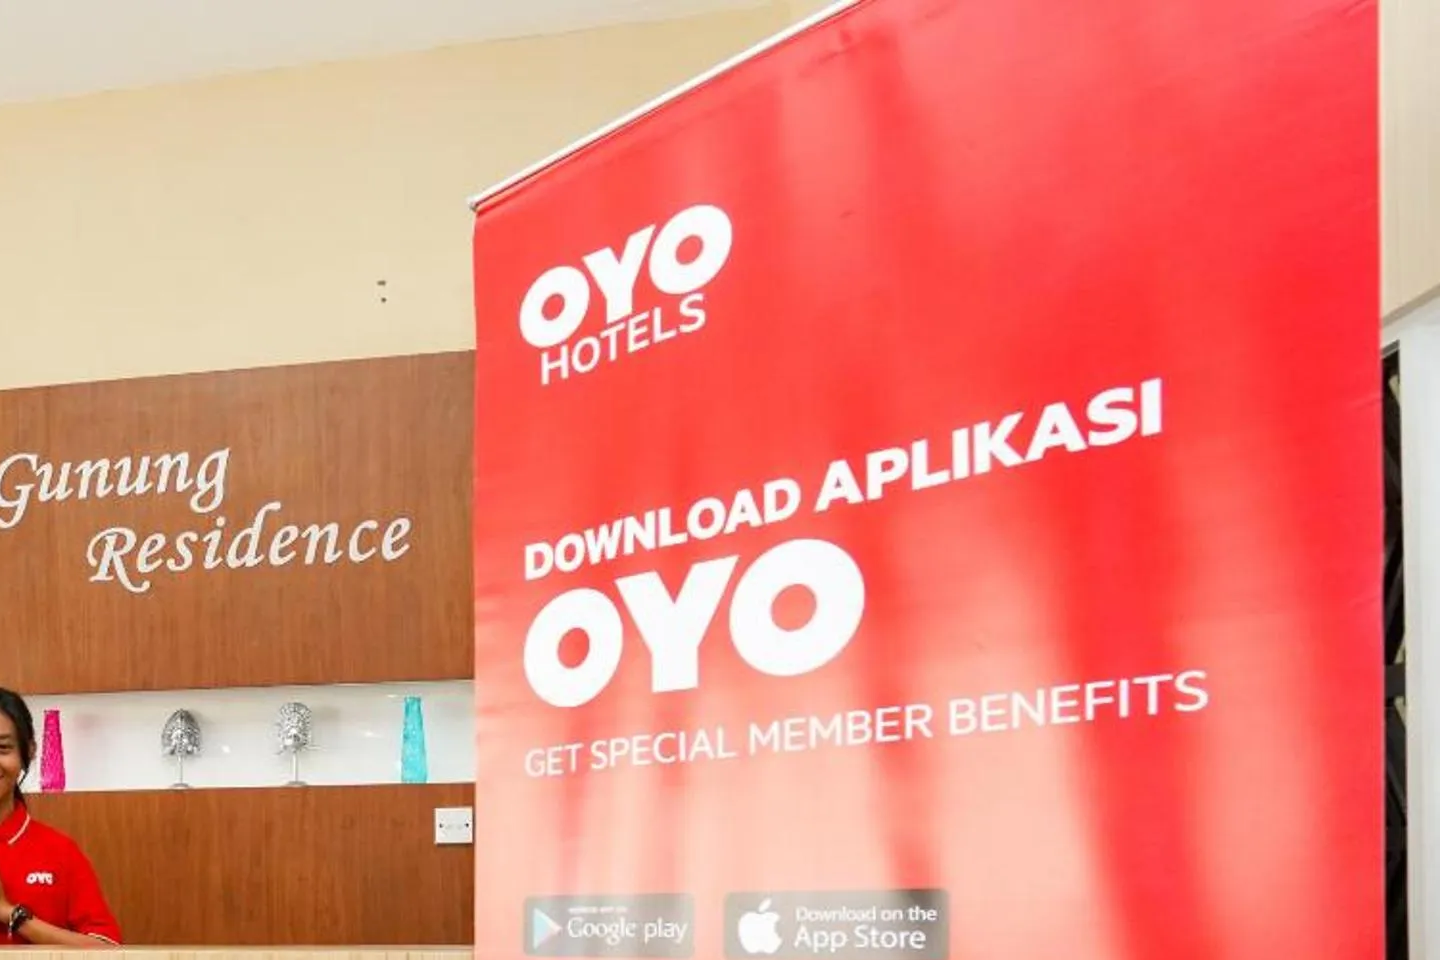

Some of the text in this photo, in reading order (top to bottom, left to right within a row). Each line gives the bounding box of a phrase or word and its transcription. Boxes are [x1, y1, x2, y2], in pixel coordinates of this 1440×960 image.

[519, 204, 733, 349] OYO
[541, 293, 707, 385] HOTELS
[524, 378, 1162, 580] DOWNLOAD APLIKASI
[86, 501, 412, 593] Residence
[523, 538, 865, 708] OYO
[525, 670, 1209, 778] GET SPECIAL MEMBER BENEFITS
[567, 916, 689, 946] Google play
[794, 923, 927, 953] App Store
[795, 906, 938, 923] Download on the
